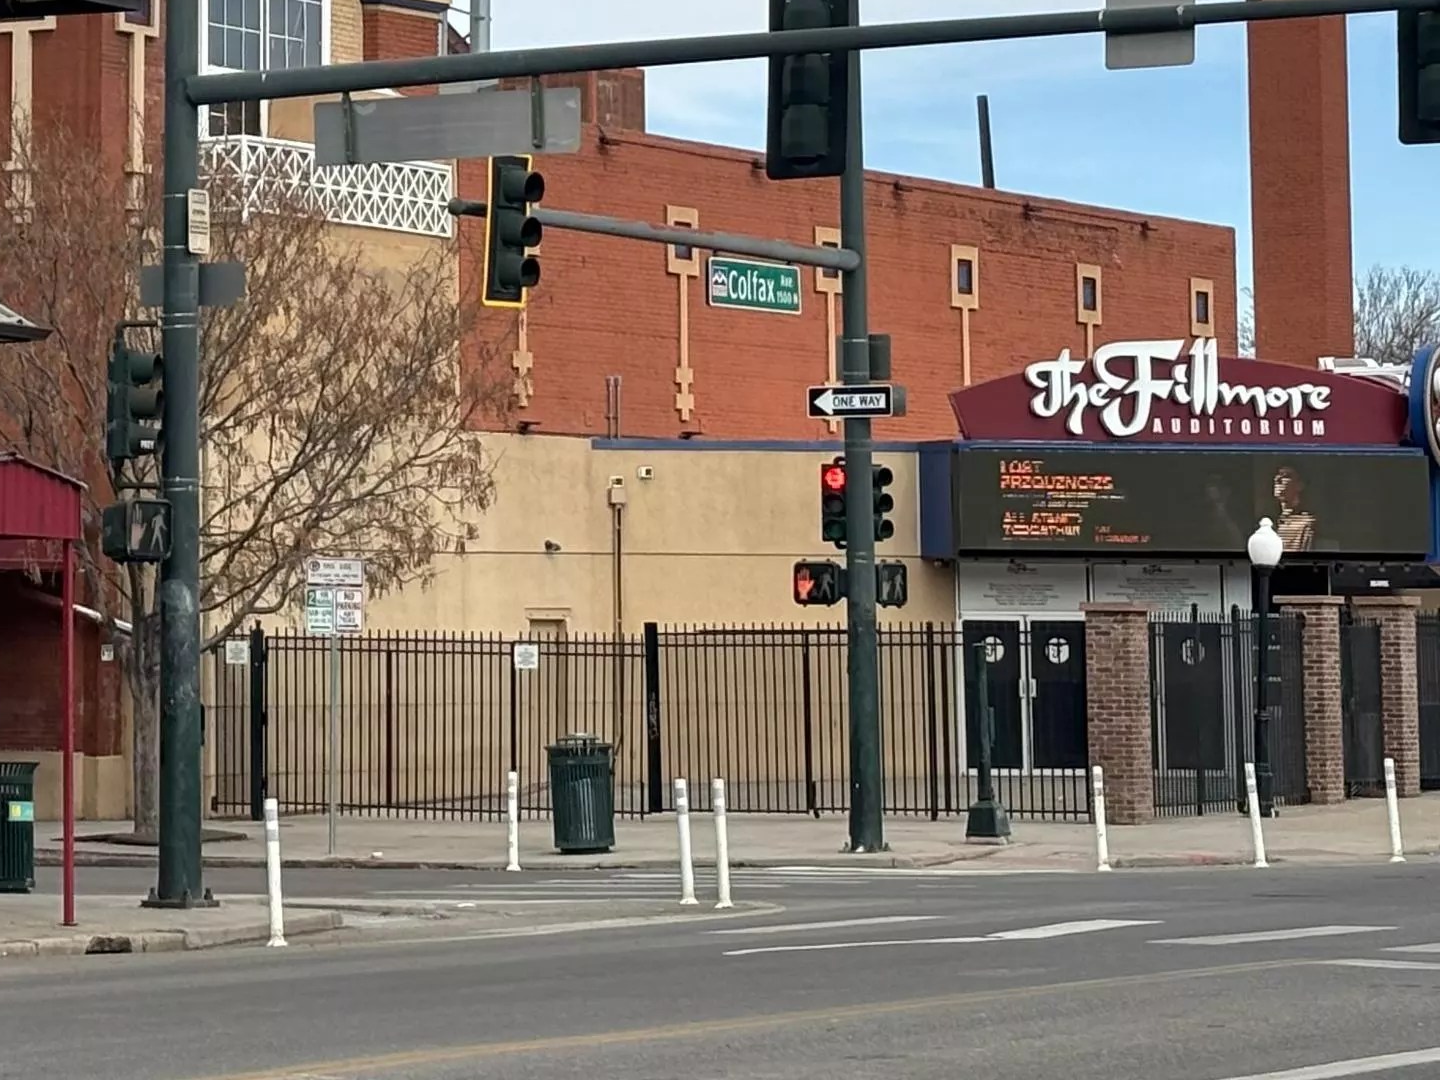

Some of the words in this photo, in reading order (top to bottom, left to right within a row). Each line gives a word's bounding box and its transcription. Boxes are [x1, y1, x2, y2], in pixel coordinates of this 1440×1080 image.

[728, 270, 776, 303] Colfax
[780, 274, 793, 287] Ave
[1024, 348, 1112, 435] The
[1092, 337, 1331, 437] Fillmore
[832, 395, 857, 408] ONE
[859, 395, 883, 407] WAY
[1152, 417, 1326, 436] AUDITORIUM
